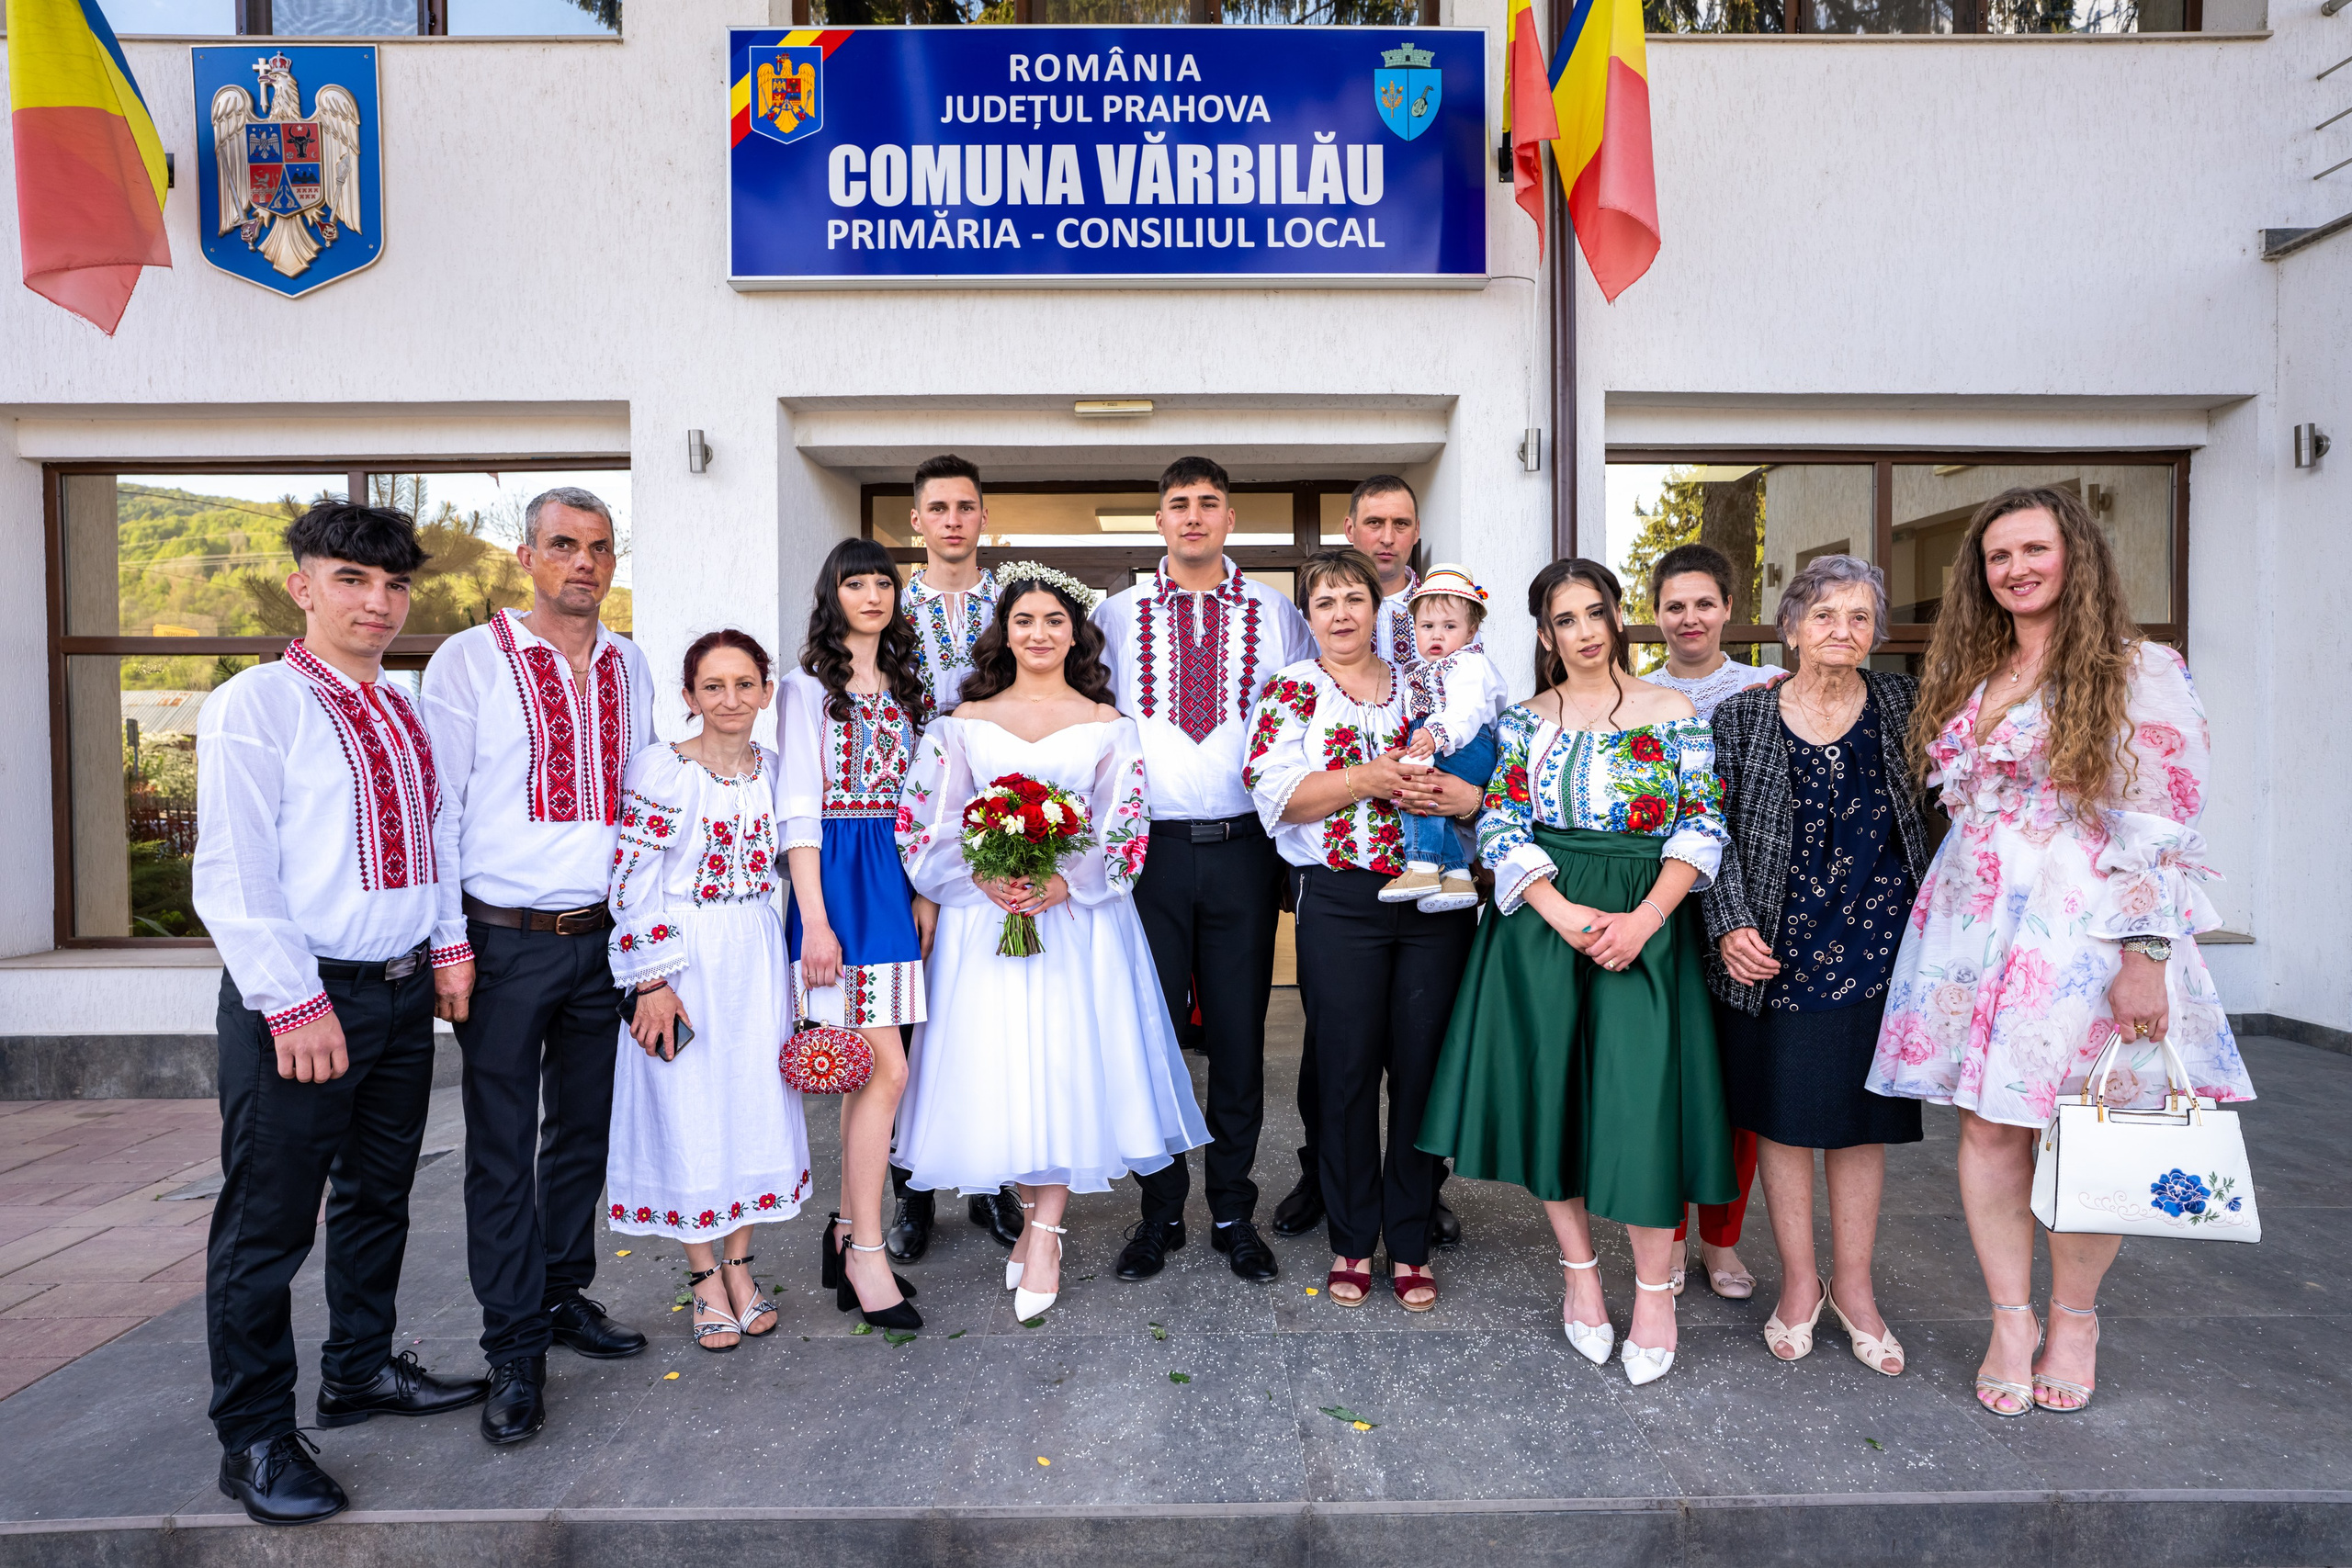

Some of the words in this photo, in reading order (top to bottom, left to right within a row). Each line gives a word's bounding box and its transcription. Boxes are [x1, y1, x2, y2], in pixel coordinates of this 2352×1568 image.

[1010, 46, 1202, 83] ROMÂNIA
[940, 95, 1093, 130] JUDEȚUL
[1102, 94, 1272, 123] PRAHOVA
[829, 143, 1085, 208] COMUNA
[1096, 130, 1385, 206] VĂRBILĂU
[827, 209, 1022, 250] PRIMĂRIA
[1056, 217, 1256, 249] CONSILIUL
[1267, 217, 1386, 249] LOCAL
